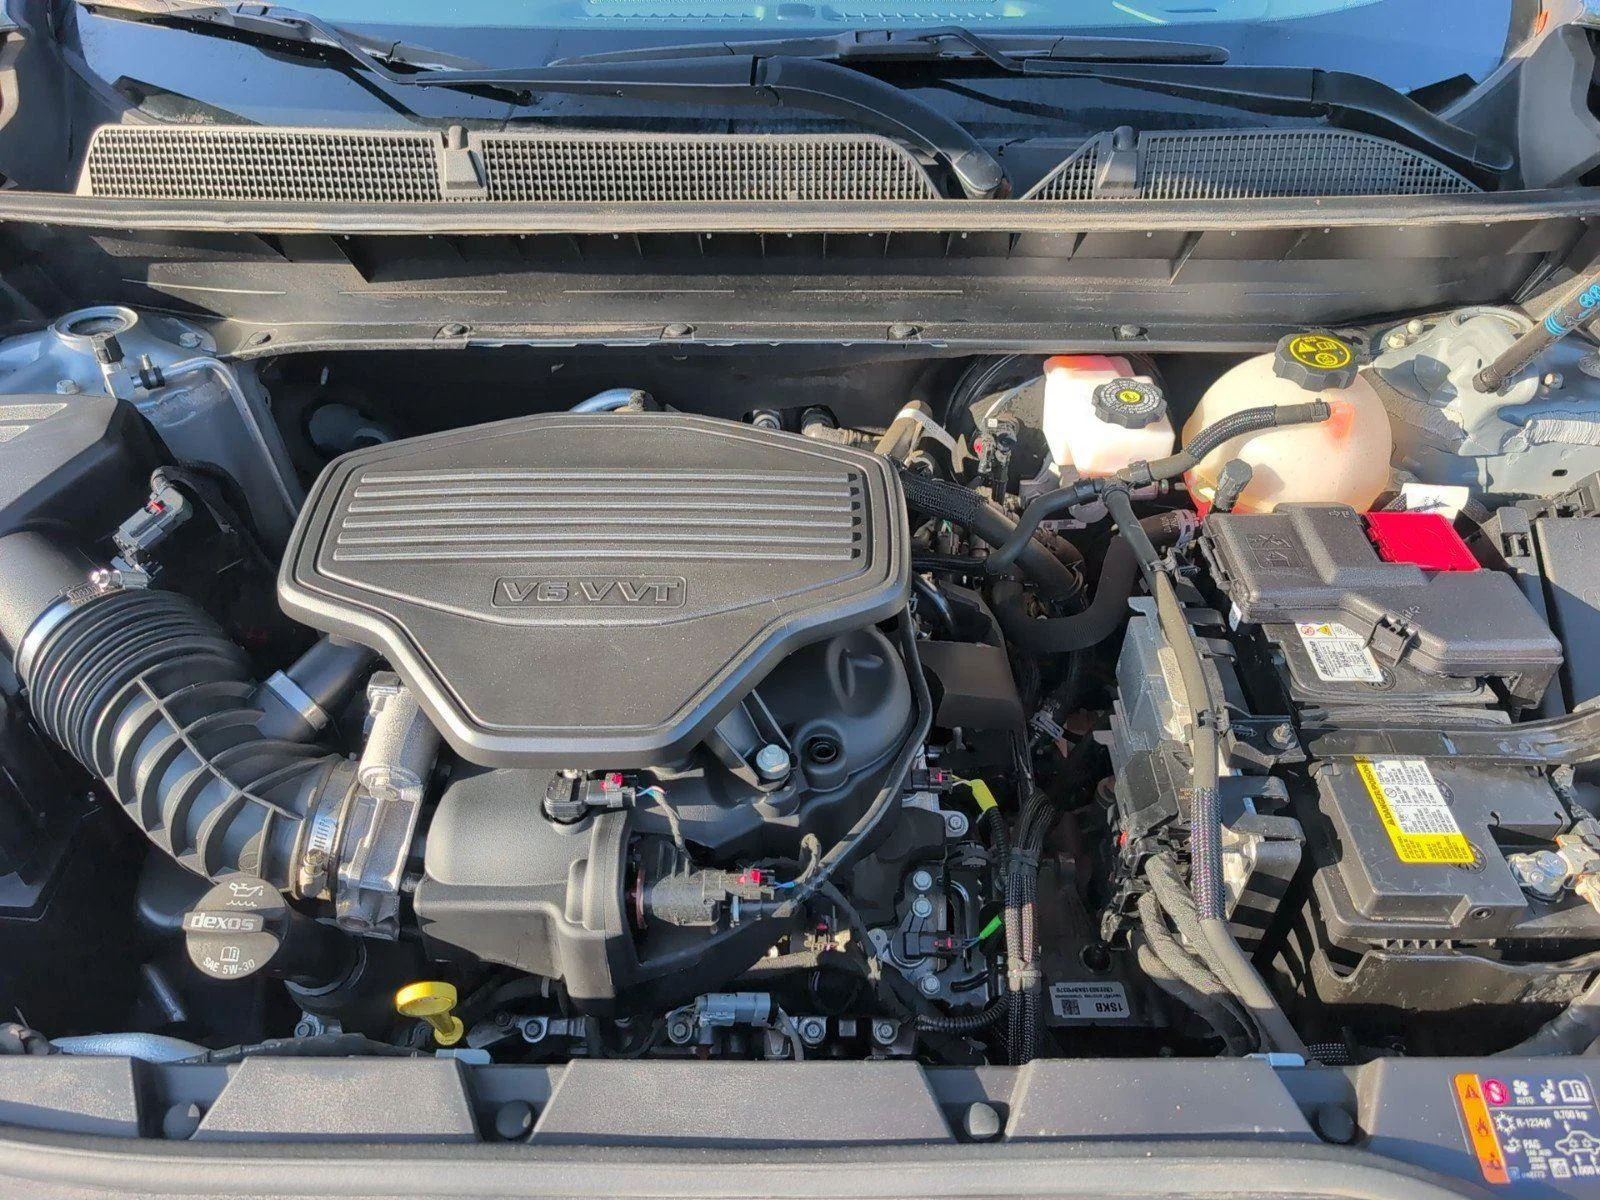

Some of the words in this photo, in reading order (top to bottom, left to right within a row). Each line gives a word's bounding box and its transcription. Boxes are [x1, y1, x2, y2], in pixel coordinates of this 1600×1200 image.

[502, 581, 569, 602] V6
[580, 581, 679, 602] VVT
[190, 912, 255, 930] dexos
[203, 957, 220, 973] SAE
[222, 959, 256, 975] 5W-30
[1516, 1096, 1534, 1105] AUTO
[1522, 1139, 1541, 1149] PAG
